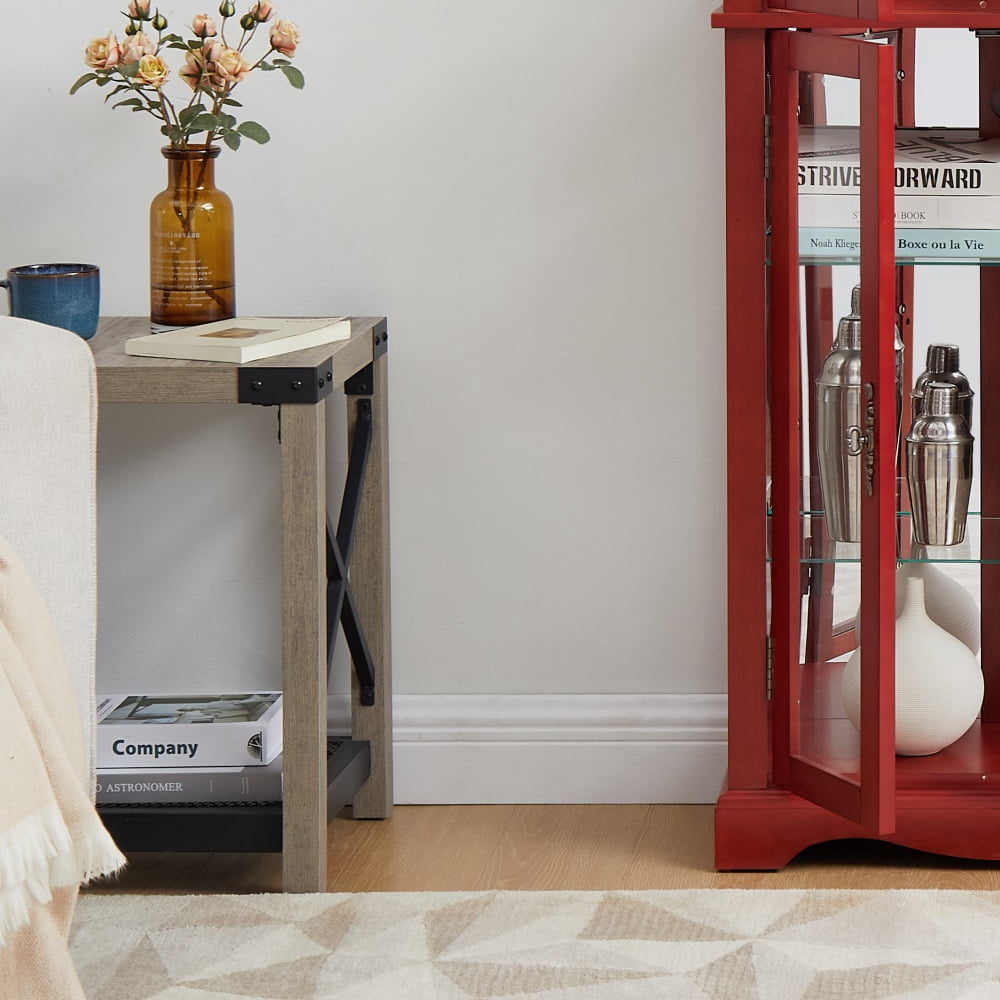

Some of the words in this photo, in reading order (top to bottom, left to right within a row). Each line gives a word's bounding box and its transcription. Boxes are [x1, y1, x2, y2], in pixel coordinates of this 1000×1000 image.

[798, 165, 860, 186] STRIVE
[895, 167, 981, 189] ORWARD
[901, 211, 926, 220] BOOK
[810, 238, 833, 247] Noah
[835, 239, 860, 250] Kliege
[898, 238, 928, 249] Boxe
[931, 242, 947, 250] ou
[950, 239, 961, 250] la
[964, 239, 984, 250] Vie
[112, 739, 199, 759] Company
[106, 782, 183, 793] ASTRONOMER
